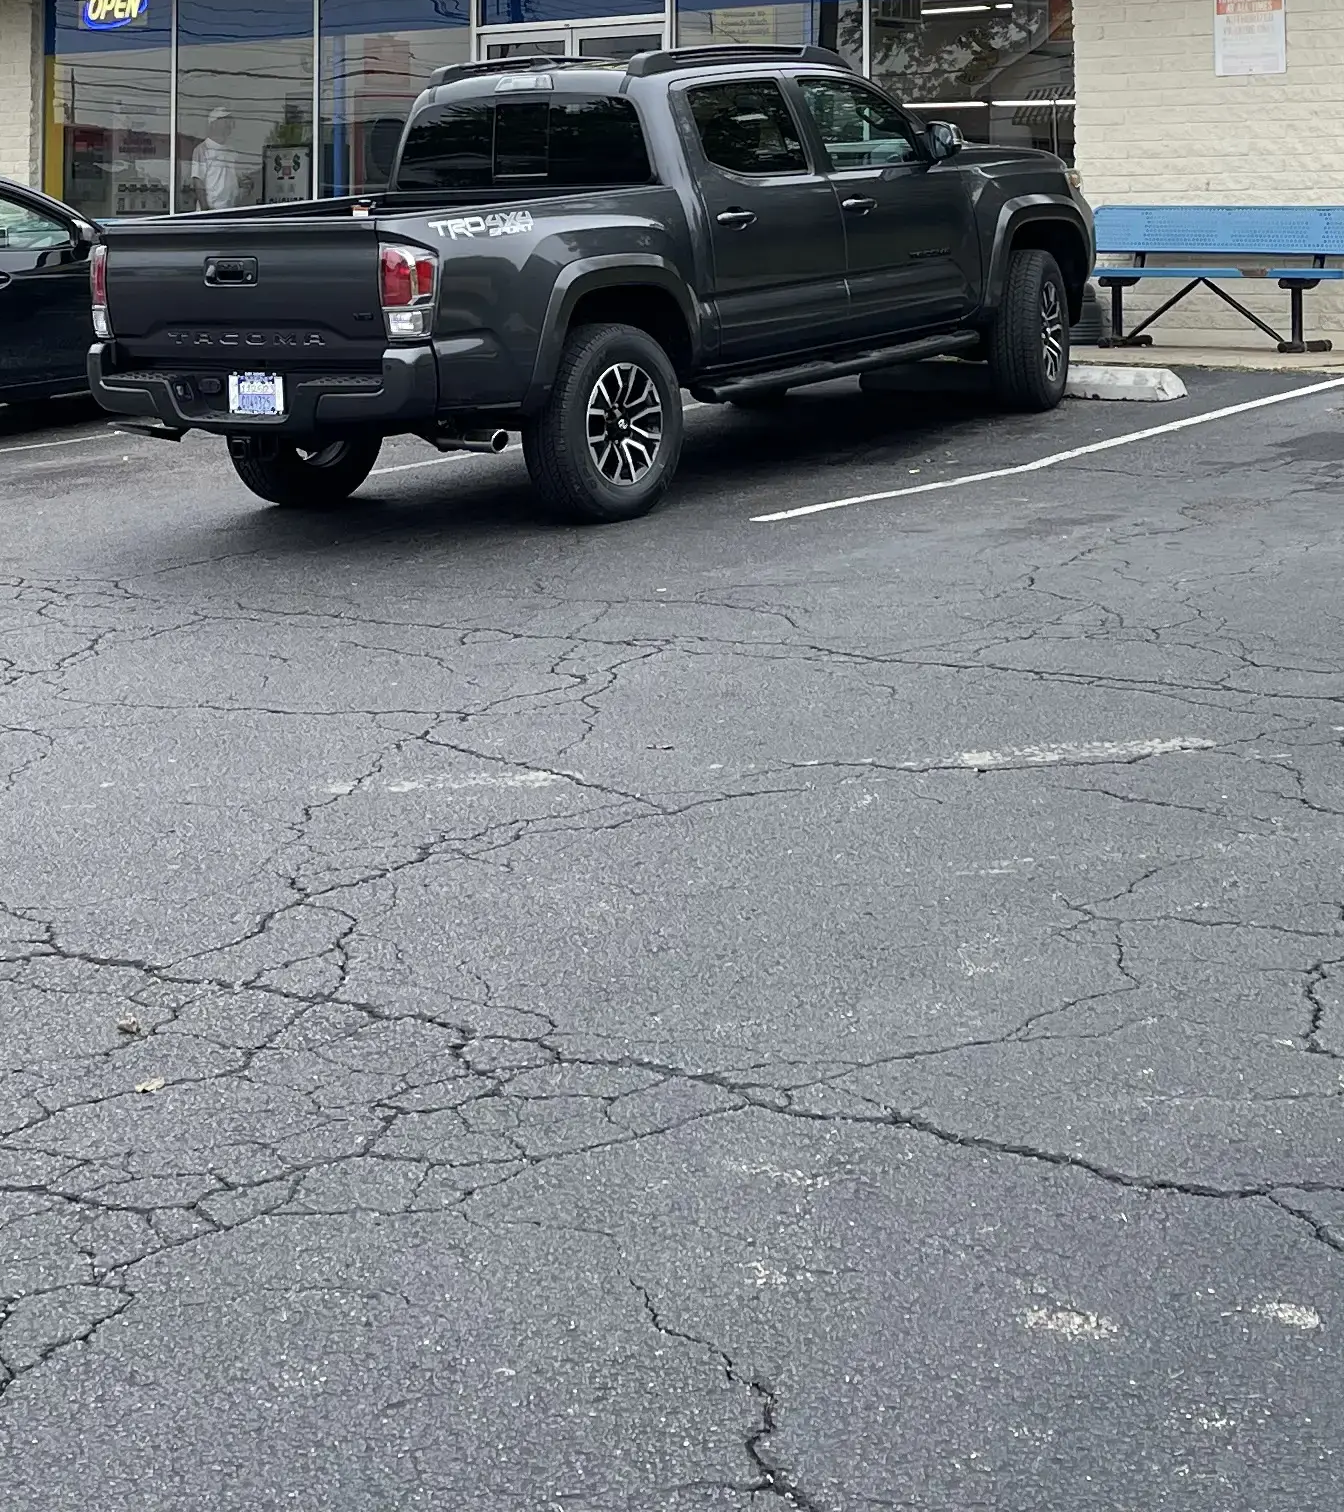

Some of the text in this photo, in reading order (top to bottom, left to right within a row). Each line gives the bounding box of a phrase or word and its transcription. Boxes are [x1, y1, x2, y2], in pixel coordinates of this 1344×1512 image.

[428, 216, 486, 240] TRD
[489, 224, 533, 237] SPORT
[167, 332, 326, 346] TACOMA
